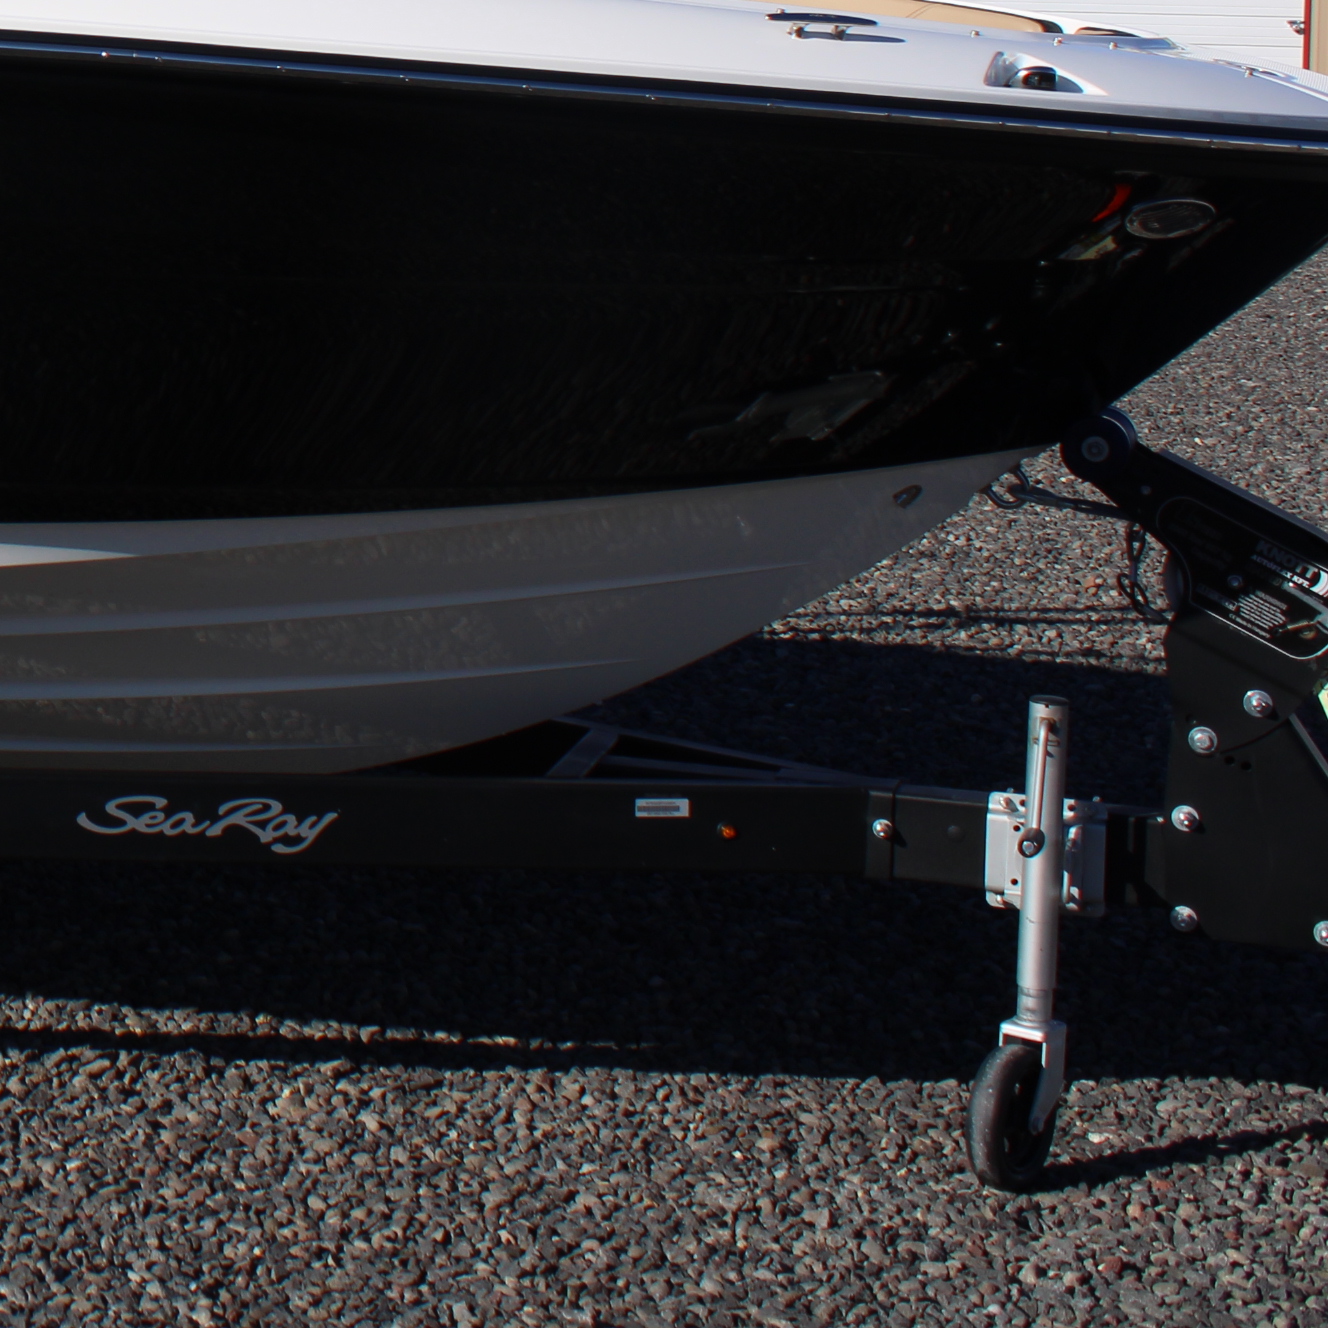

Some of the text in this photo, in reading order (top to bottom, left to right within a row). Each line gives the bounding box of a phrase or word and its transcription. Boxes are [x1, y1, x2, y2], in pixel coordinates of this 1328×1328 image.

[1255, 540, 1319, 578] KNOTT
[76, 795, 338, 854] Sea Ray
